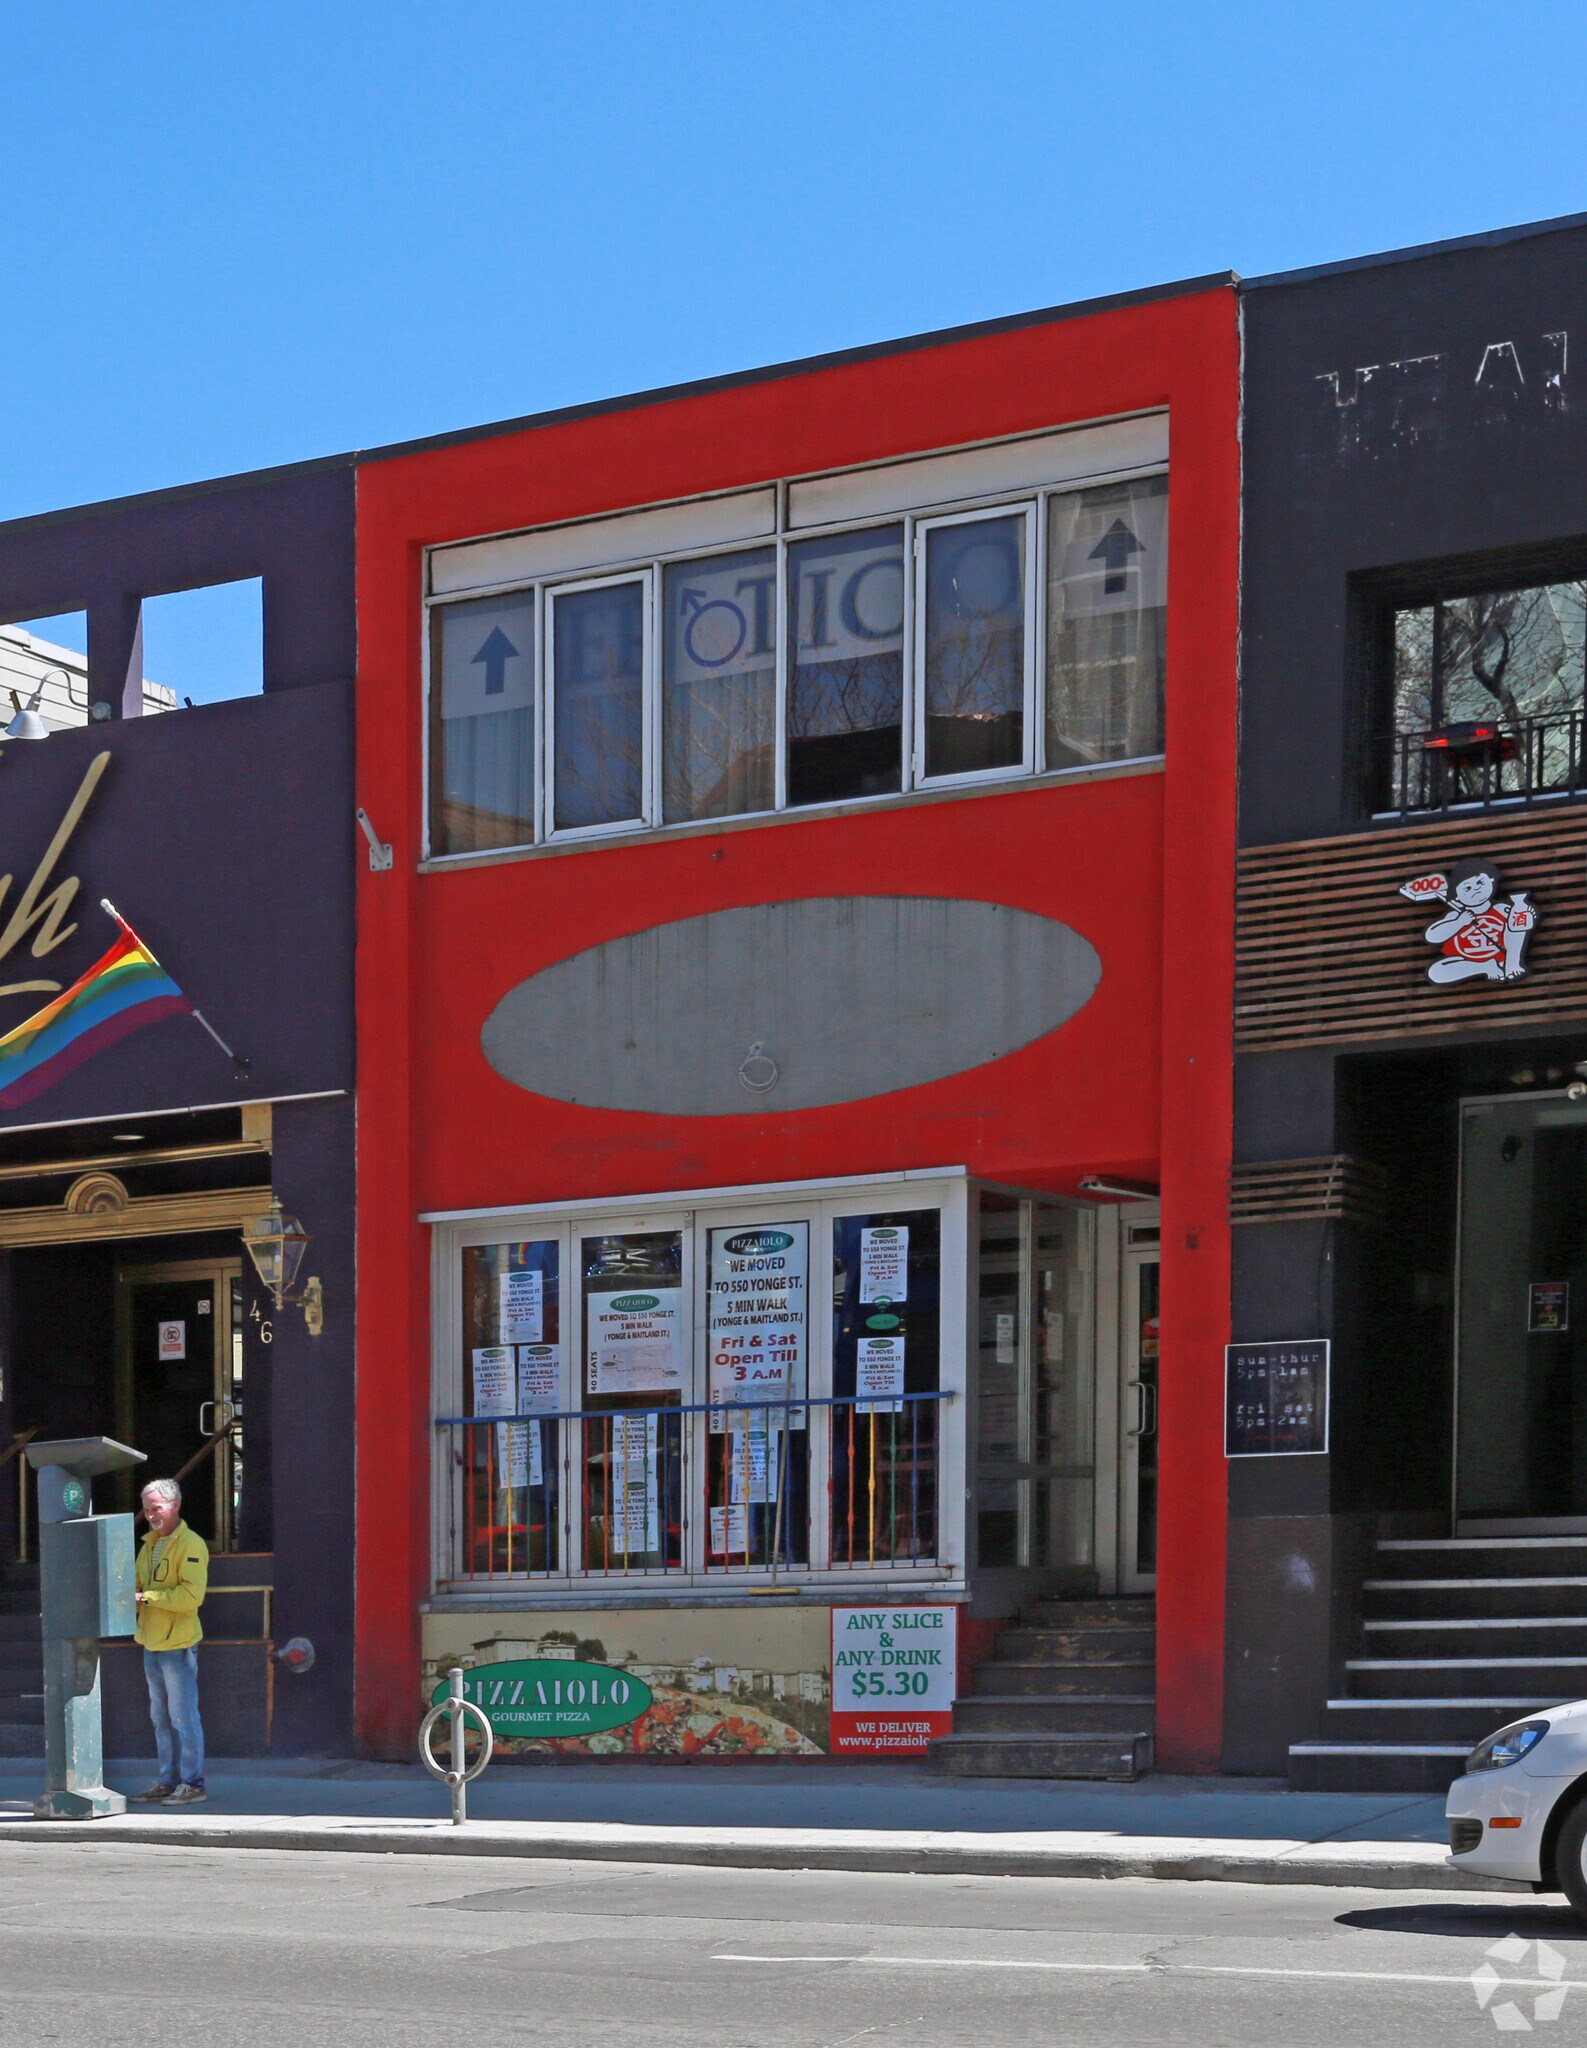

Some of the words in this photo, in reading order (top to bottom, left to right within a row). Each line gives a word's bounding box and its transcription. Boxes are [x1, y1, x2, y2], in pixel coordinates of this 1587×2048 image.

[1512, 912, 1527, 926] 酒
[732, 1236, 783, 1248] PIZZAIOLO
[730, 1260, 745, 1272] WE
[748, 1257, 785, 1271] MOVED
[715, 1281, 729, 1294] TO
[731, 1280, 748, 1293] 550
[751, 1277, 786, 1291] YONGE
[788, 1276, 802, 1288] ST.
[727, 1301, 732, 1314] 5
[735, 1300, 754, 1313] MIN
[757, 1297, 787, 1311] WALK
[609, 1313, 628, 1321] MOVED
[744, 1316, 749, 1325] &
[750, 1314, 789, 1324] MAITLAND
[721, 1336, 744, 1349] Fri
[749, 1335, 762, 1347] &
[768, 1334, 797, 1346] Sat
[714, 1353, 764, 1368] Open
[769, 1350, 797, 1362] Till
[734, 1366, 747, 1381] 3
[591, 1381, 597, 1391] 40
[713, 1419, 719, 1430] 40
[70, 1490, 78, 1500] P
[846, 1614, 887, 1630] ANY
[892, 1613, 943, 1629] SLICE
[879, 1632, 894, 1648] &
[835, 1651, 875, 1666] ANY
[881, 1650, 942, 1666] DRINK
[852, 1669, 929, 1698] $5.30
[491, 1712, 552, 1722] GOURMET
[556, 1712, 590, 1721] PIZZA
[856, 1722, 876, 1732] WE
[879, 1722, 931, 1733] DELIVER
